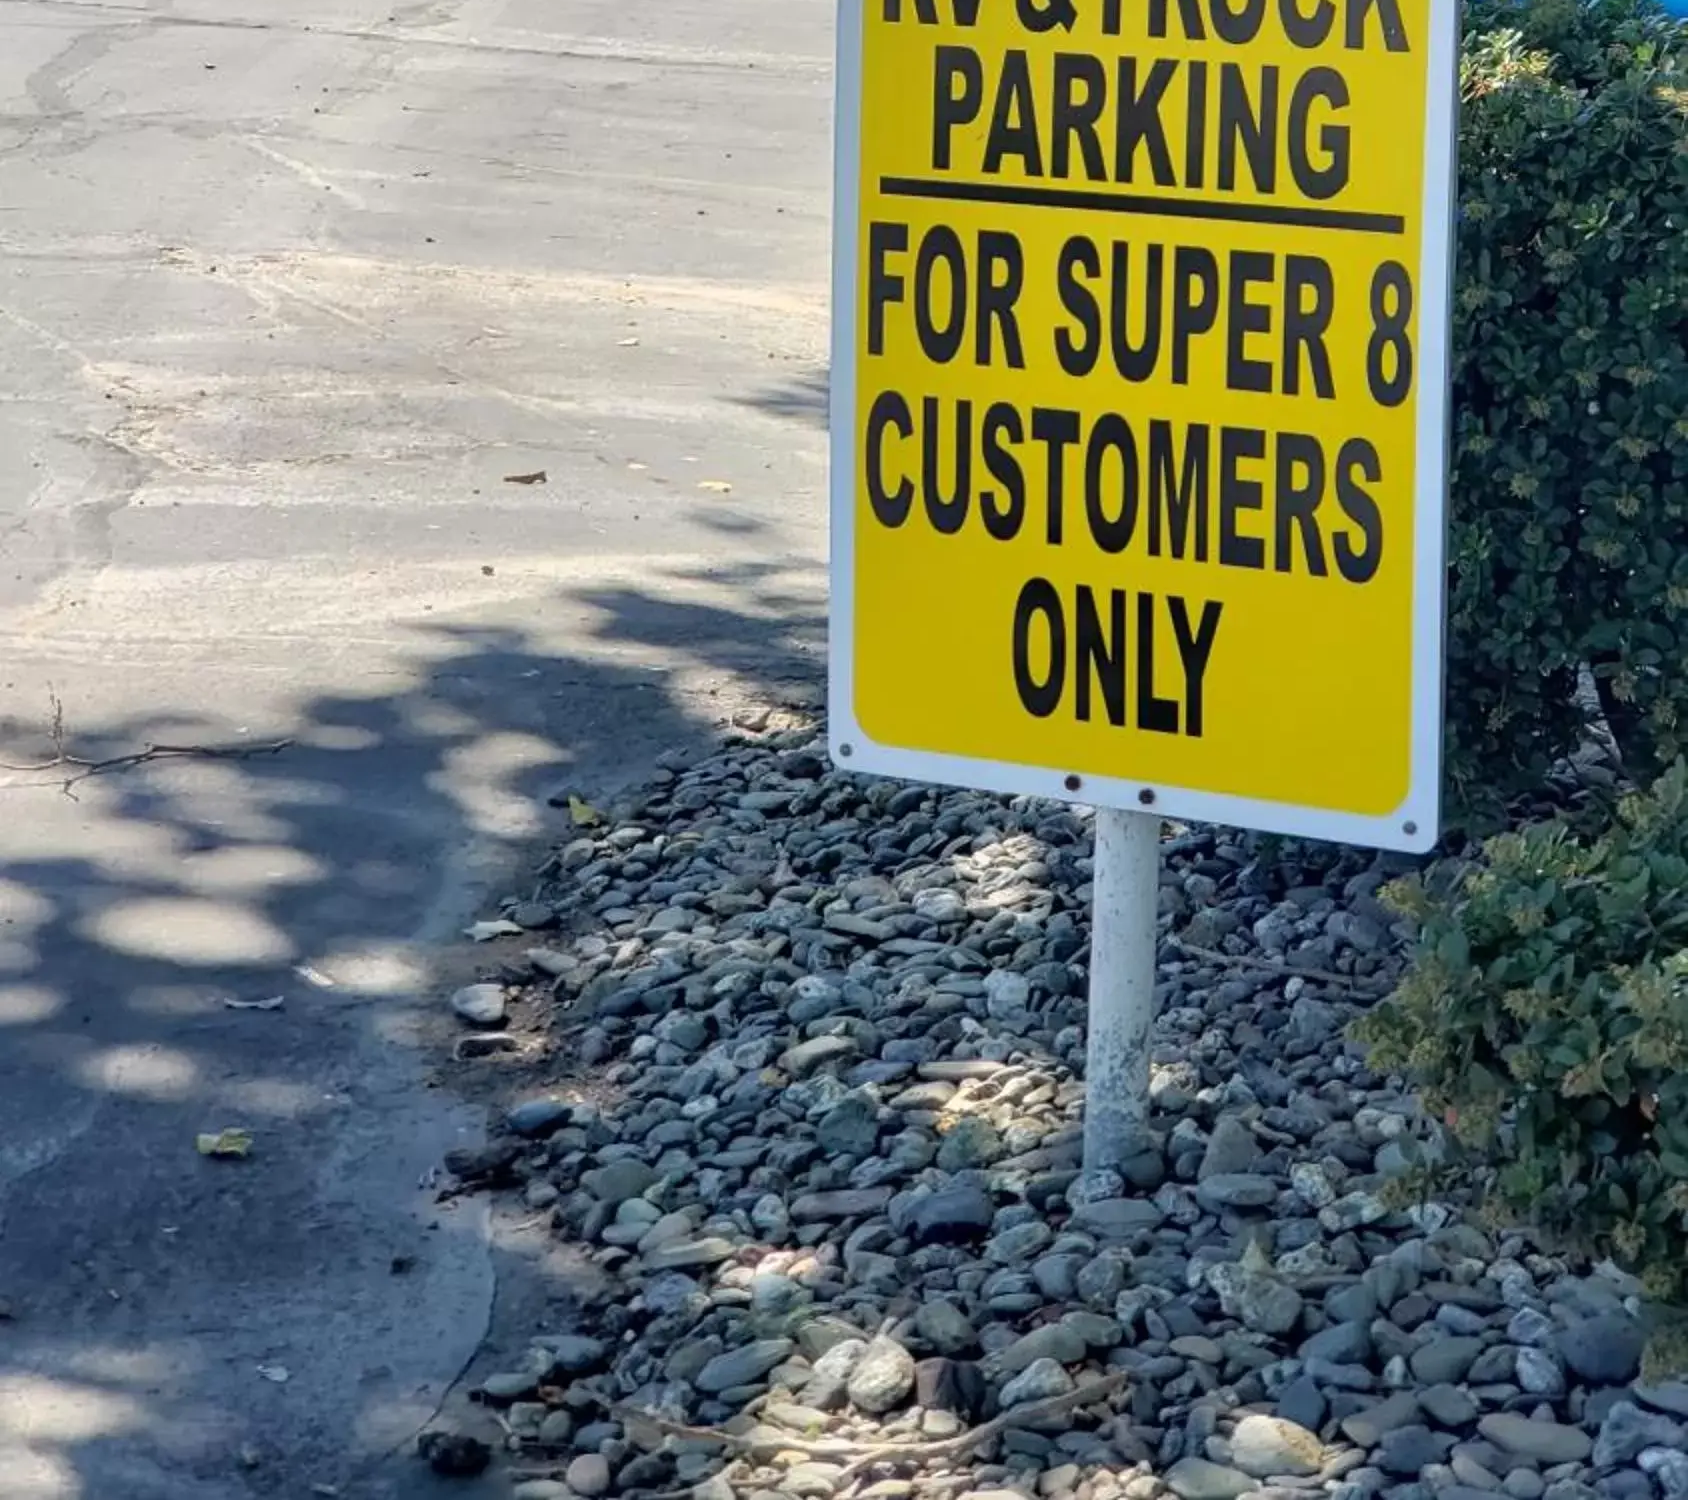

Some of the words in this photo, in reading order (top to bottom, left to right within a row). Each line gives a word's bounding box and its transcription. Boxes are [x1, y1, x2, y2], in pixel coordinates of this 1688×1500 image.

[931, 44, 1351, 201] PARKING
[867, 221, 1026, 370] FOR
[1053, 235, 1336, 400] SUPER
[1366, 260, 1413, 408] 8
[865, 389, 1383, 585] CUSTOMERS
[1012, 576, 1224, 738] ONLY
